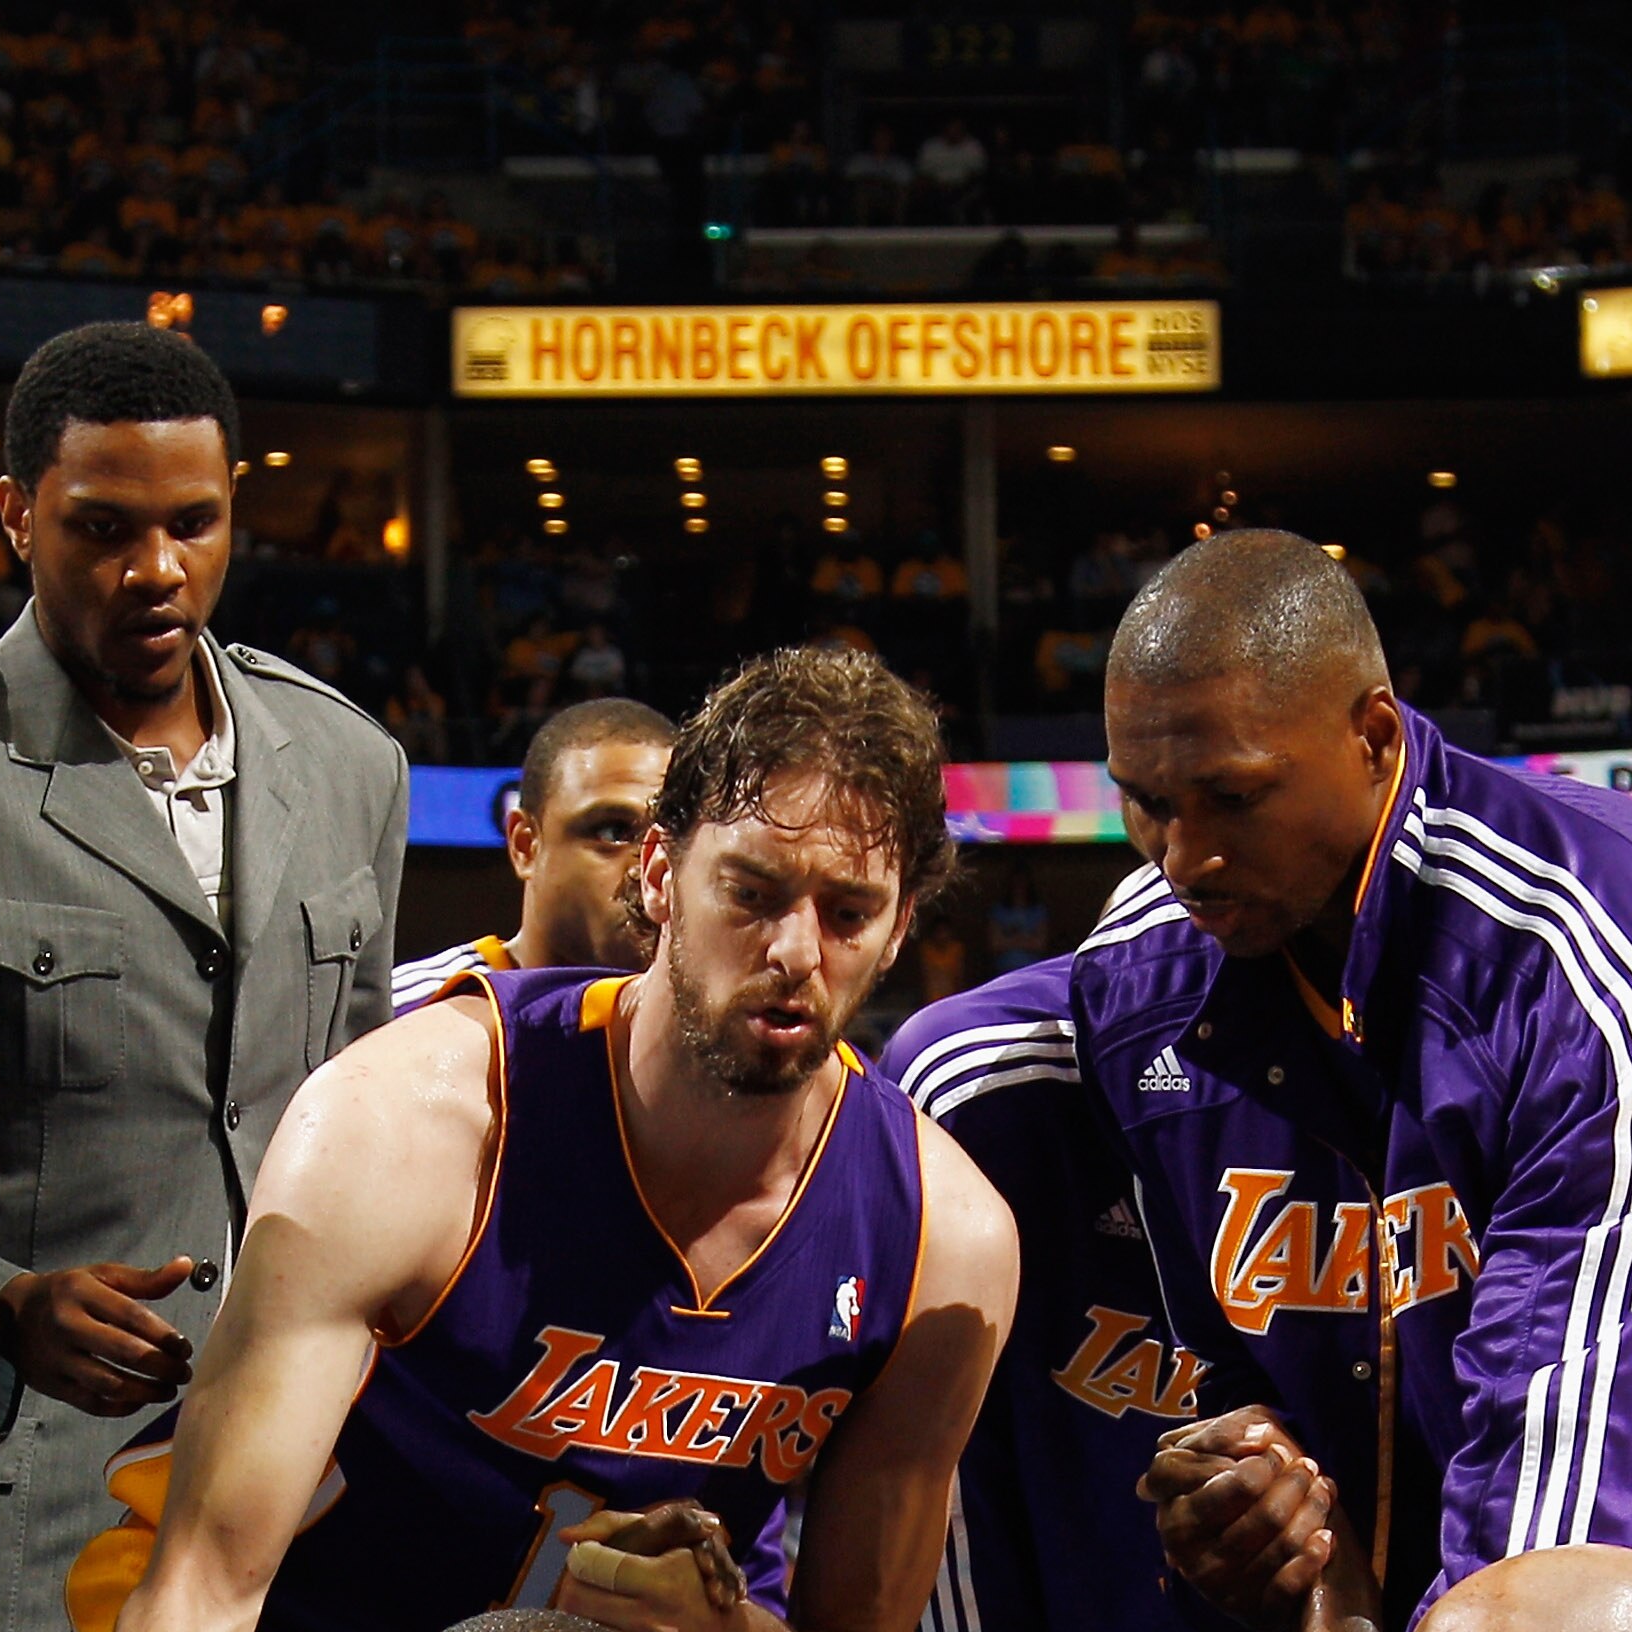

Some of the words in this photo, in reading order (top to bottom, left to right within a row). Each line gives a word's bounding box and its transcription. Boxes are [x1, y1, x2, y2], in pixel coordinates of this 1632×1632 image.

[531, 315, 828, 381] HORNBECK
[848, 311, 1136, 378] OFFSHORE
[1136, 1072, 1191, 1093] adidas
[467, 1322, 855, 1486] LAKERS
